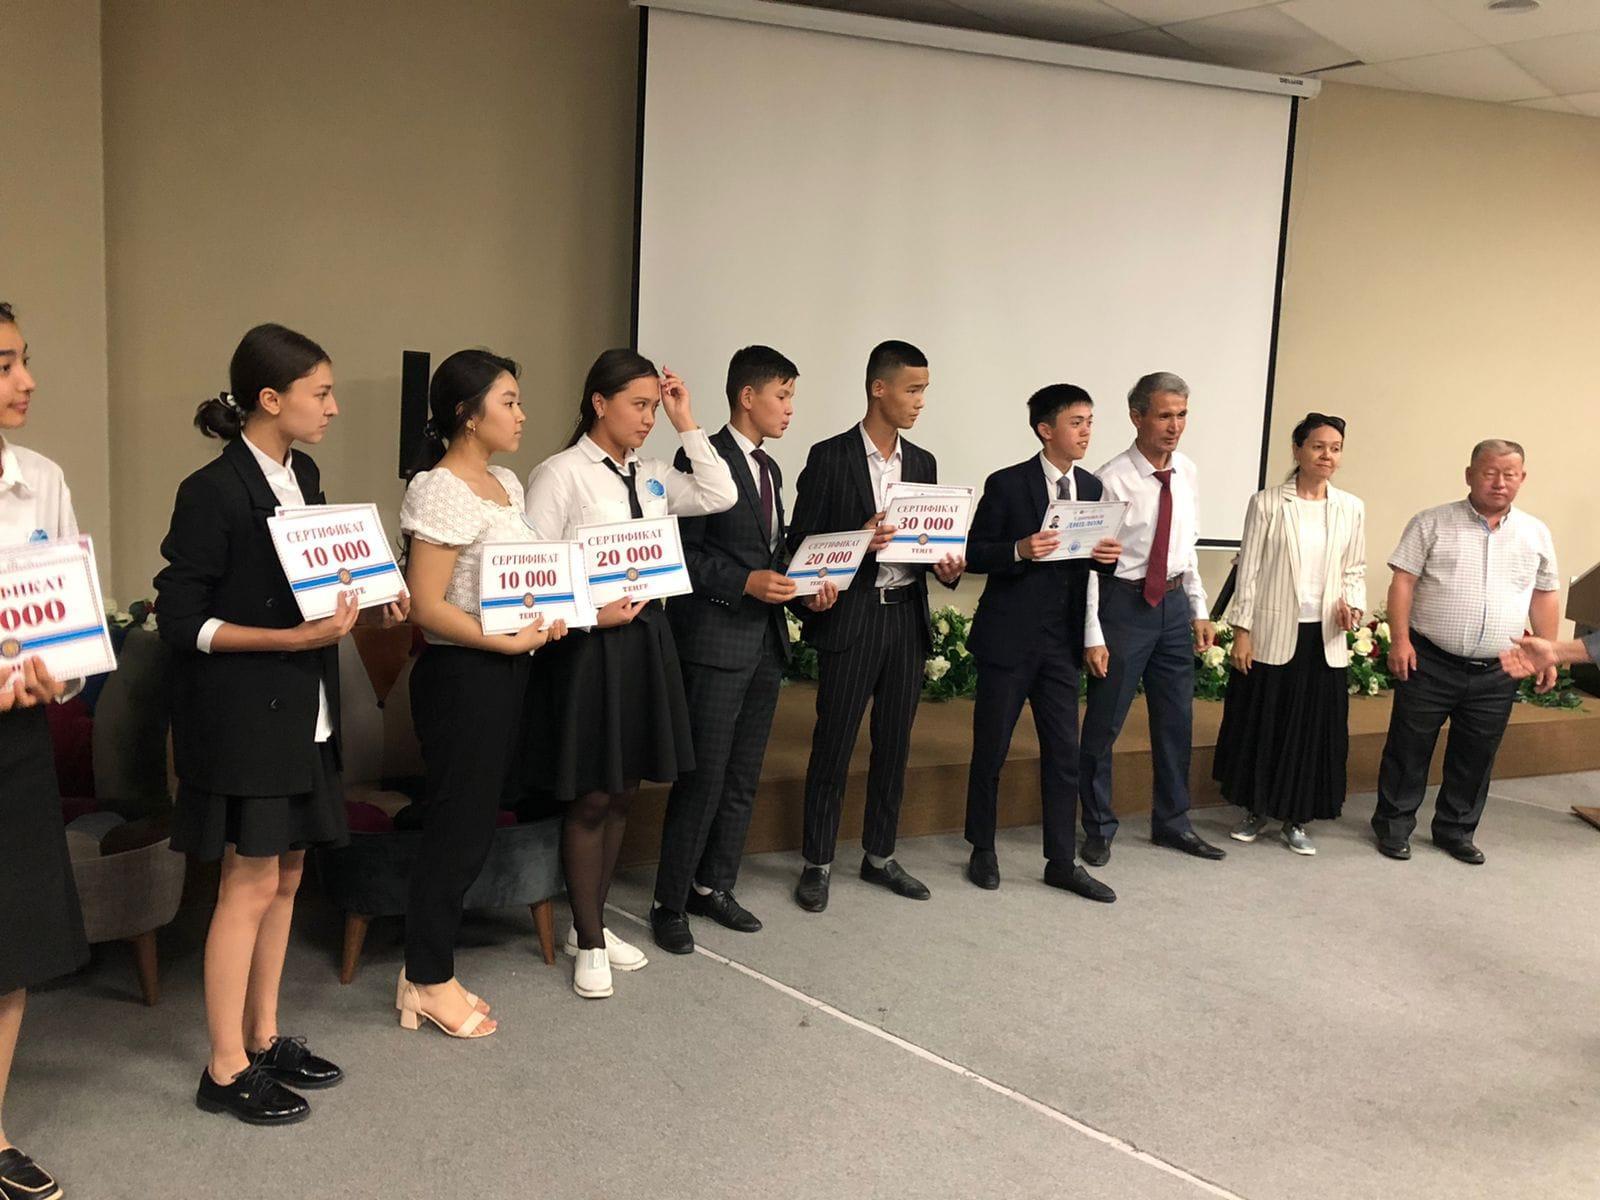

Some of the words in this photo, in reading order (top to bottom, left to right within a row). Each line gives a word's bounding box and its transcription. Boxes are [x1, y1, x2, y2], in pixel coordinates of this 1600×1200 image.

[896, 504, 960, 514] СЕРТИФИКАТ
[286, 520, 365, 543] СЕРТИФИКАТ
[897, 516, 919, 531] 30
[923, 516, 955, 531] 000
[587, 528, 664, 547] СЕРТИФИКАТ
[808, 540, 860, 550] СЕРТИФИКАТ
[301, 546, 329, 569] 10
[332, 539, 371, 563] 000
[491, 552, 559, 566] СЕРТИФИКАТ
[595, 548, 621, 568] 20
[625, 543, 664, 564] 000
[805, 553, 824, 566] 20
[826, 551, 852, 564] 000
[498, 570, 519, 590] 10
[525, 569, 558, 588] 000
[0, 600, 66, 631] 000
